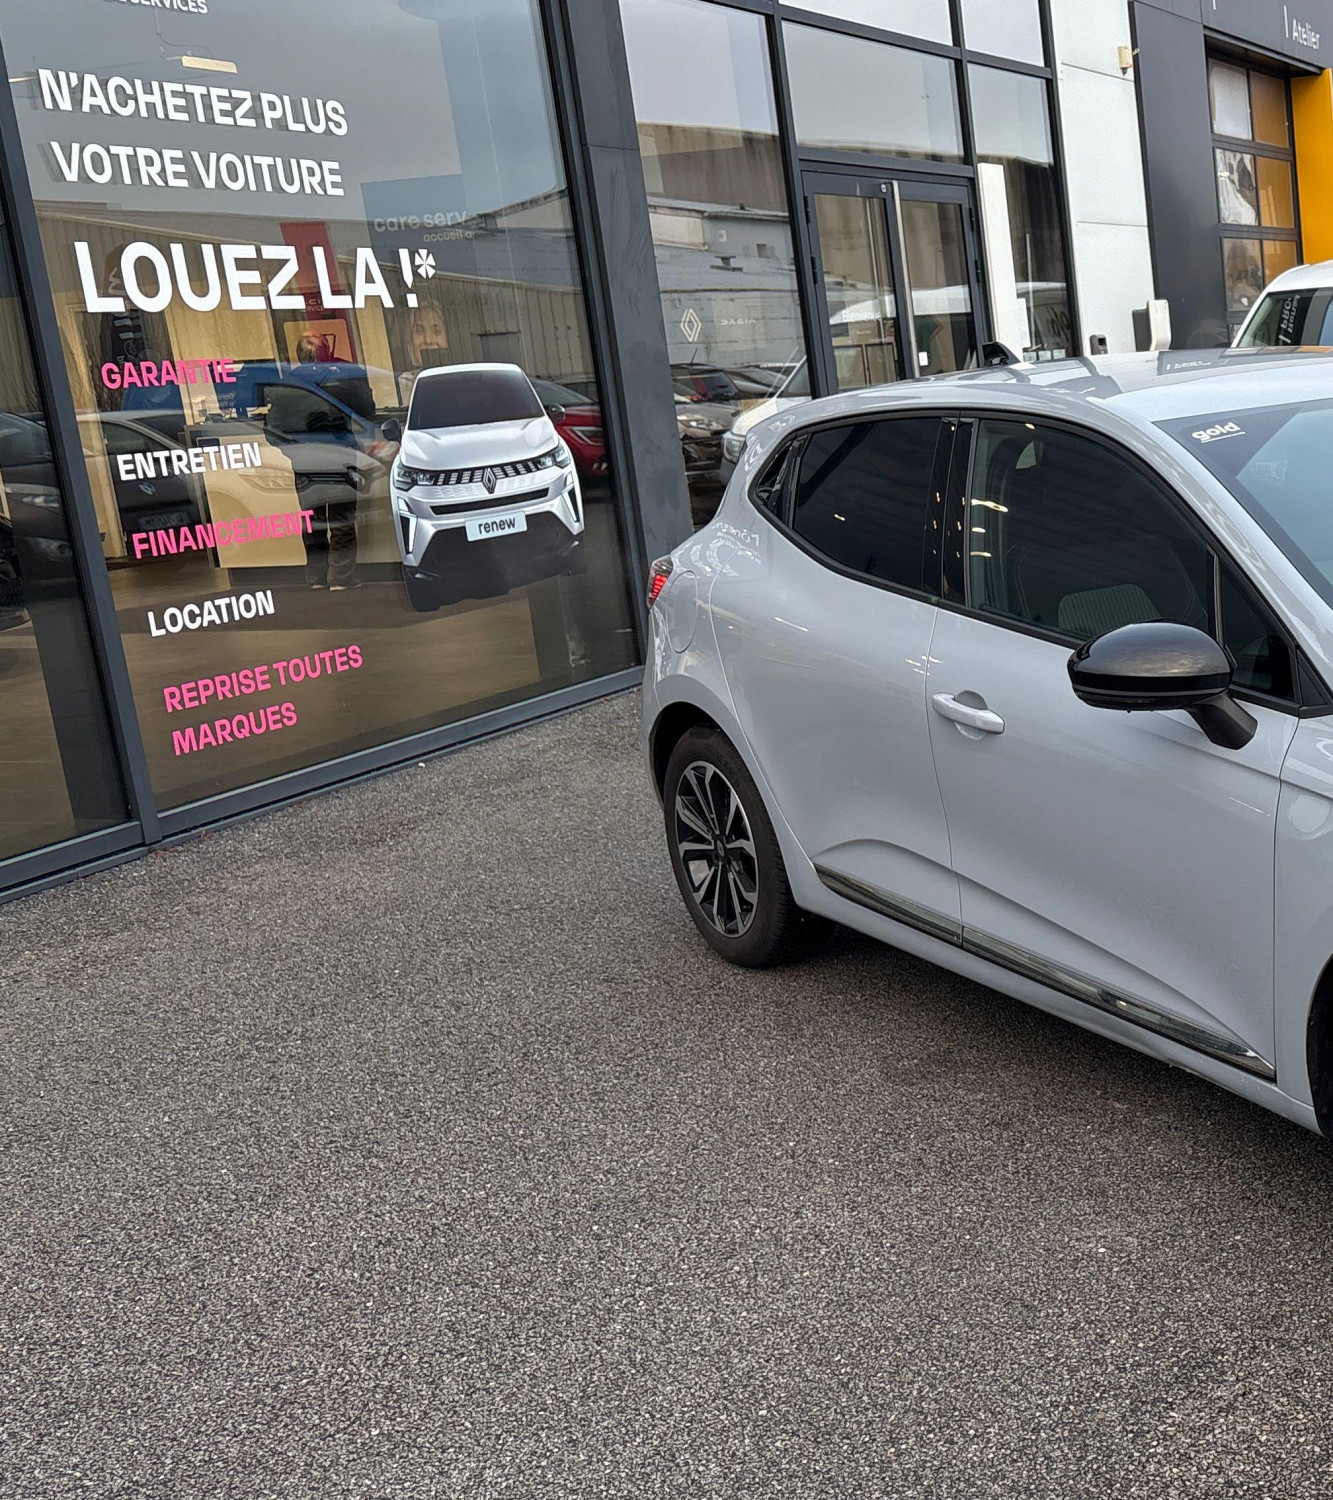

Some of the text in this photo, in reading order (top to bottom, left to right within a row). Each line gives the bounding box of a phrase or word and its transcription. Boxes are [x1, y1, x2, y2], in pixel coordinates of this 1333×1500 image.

[1292, 18, 1320, 50] Atelier
[38, 68, 349, 137] N'ACHETEZ PLUS
[50, 141, 345, 197] VOTRE VOITURE
[374, 215, 420, 233] care
[423, 229, 463, 242] accueil
[74, 241, 306, 313] LOUEZ
[312, 246, 395, 309] LA
[101, 357, 237, 389] GARANTIE
[1191, 422, 1241, 441] gold
[117, 442, 262, 481] ENTRETIEN
[132, 509, 314, 559] FINANCEMENT
[478, 517, 516, 535] renew
[147, 590, 275, 637] LOCATION
[163, 645, 364, 713] REPRISE TOUTES
[172, 702, 297, 756] MARQUES
